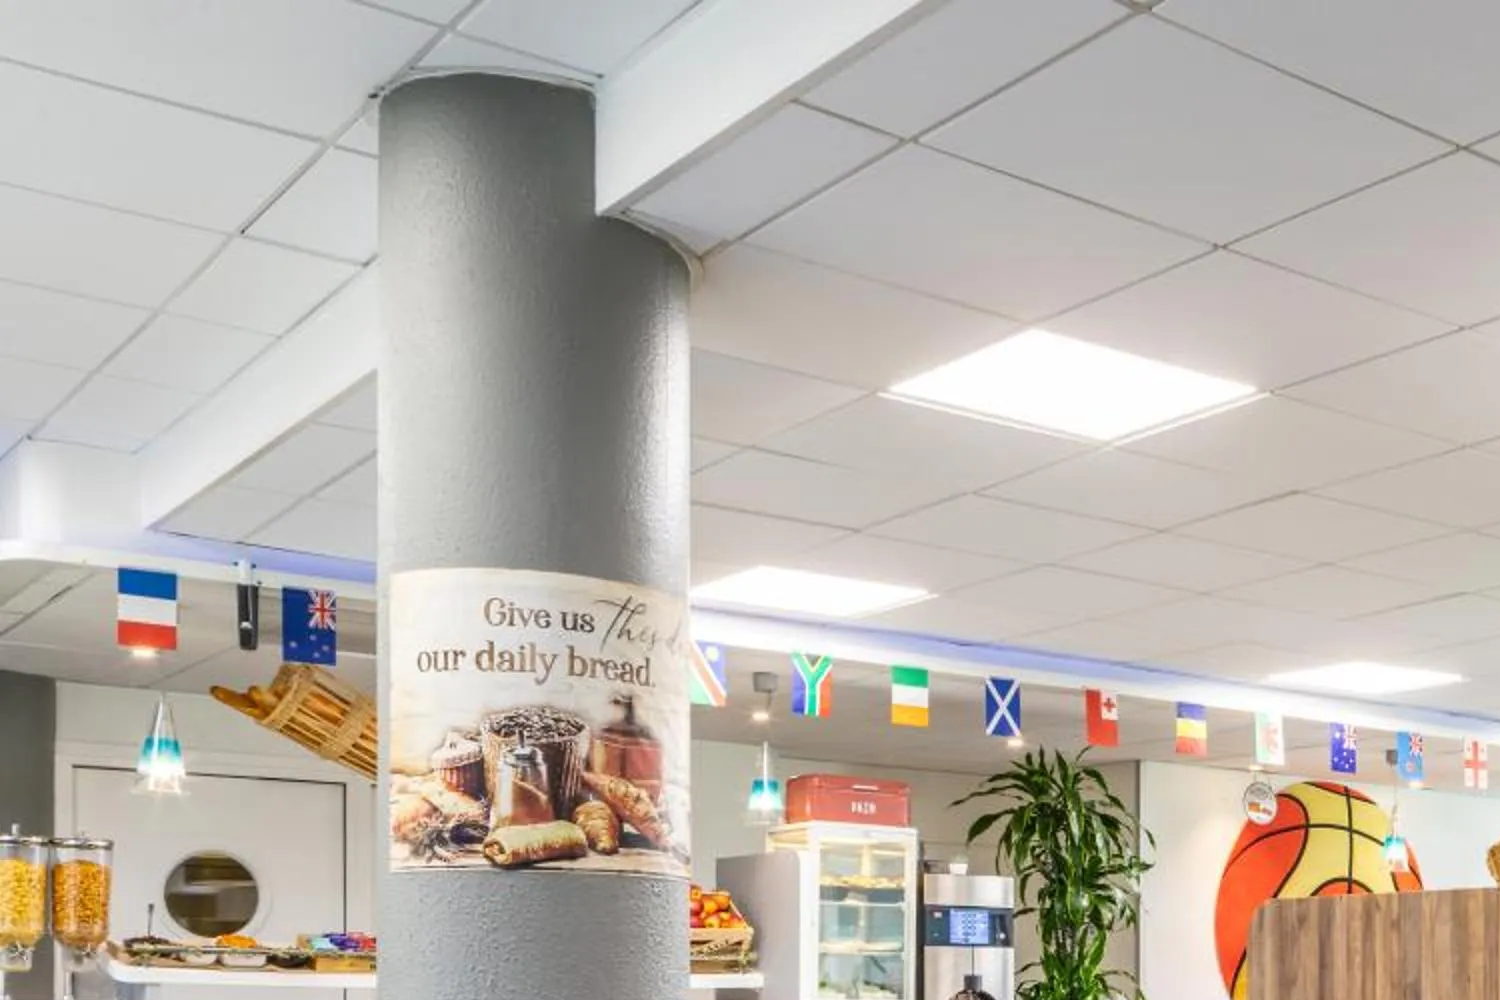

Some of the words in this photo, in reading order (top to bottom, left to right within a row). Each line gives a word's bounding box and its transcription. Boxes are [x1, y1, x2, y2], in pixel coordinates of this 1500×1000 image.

[483, 597, 552, 629] Give
[559, 610, 596, 634] us
[417, 648, 467, 673] our
[474, 639, 559, 686] daily
[565, 643, 657, 688] bread.
